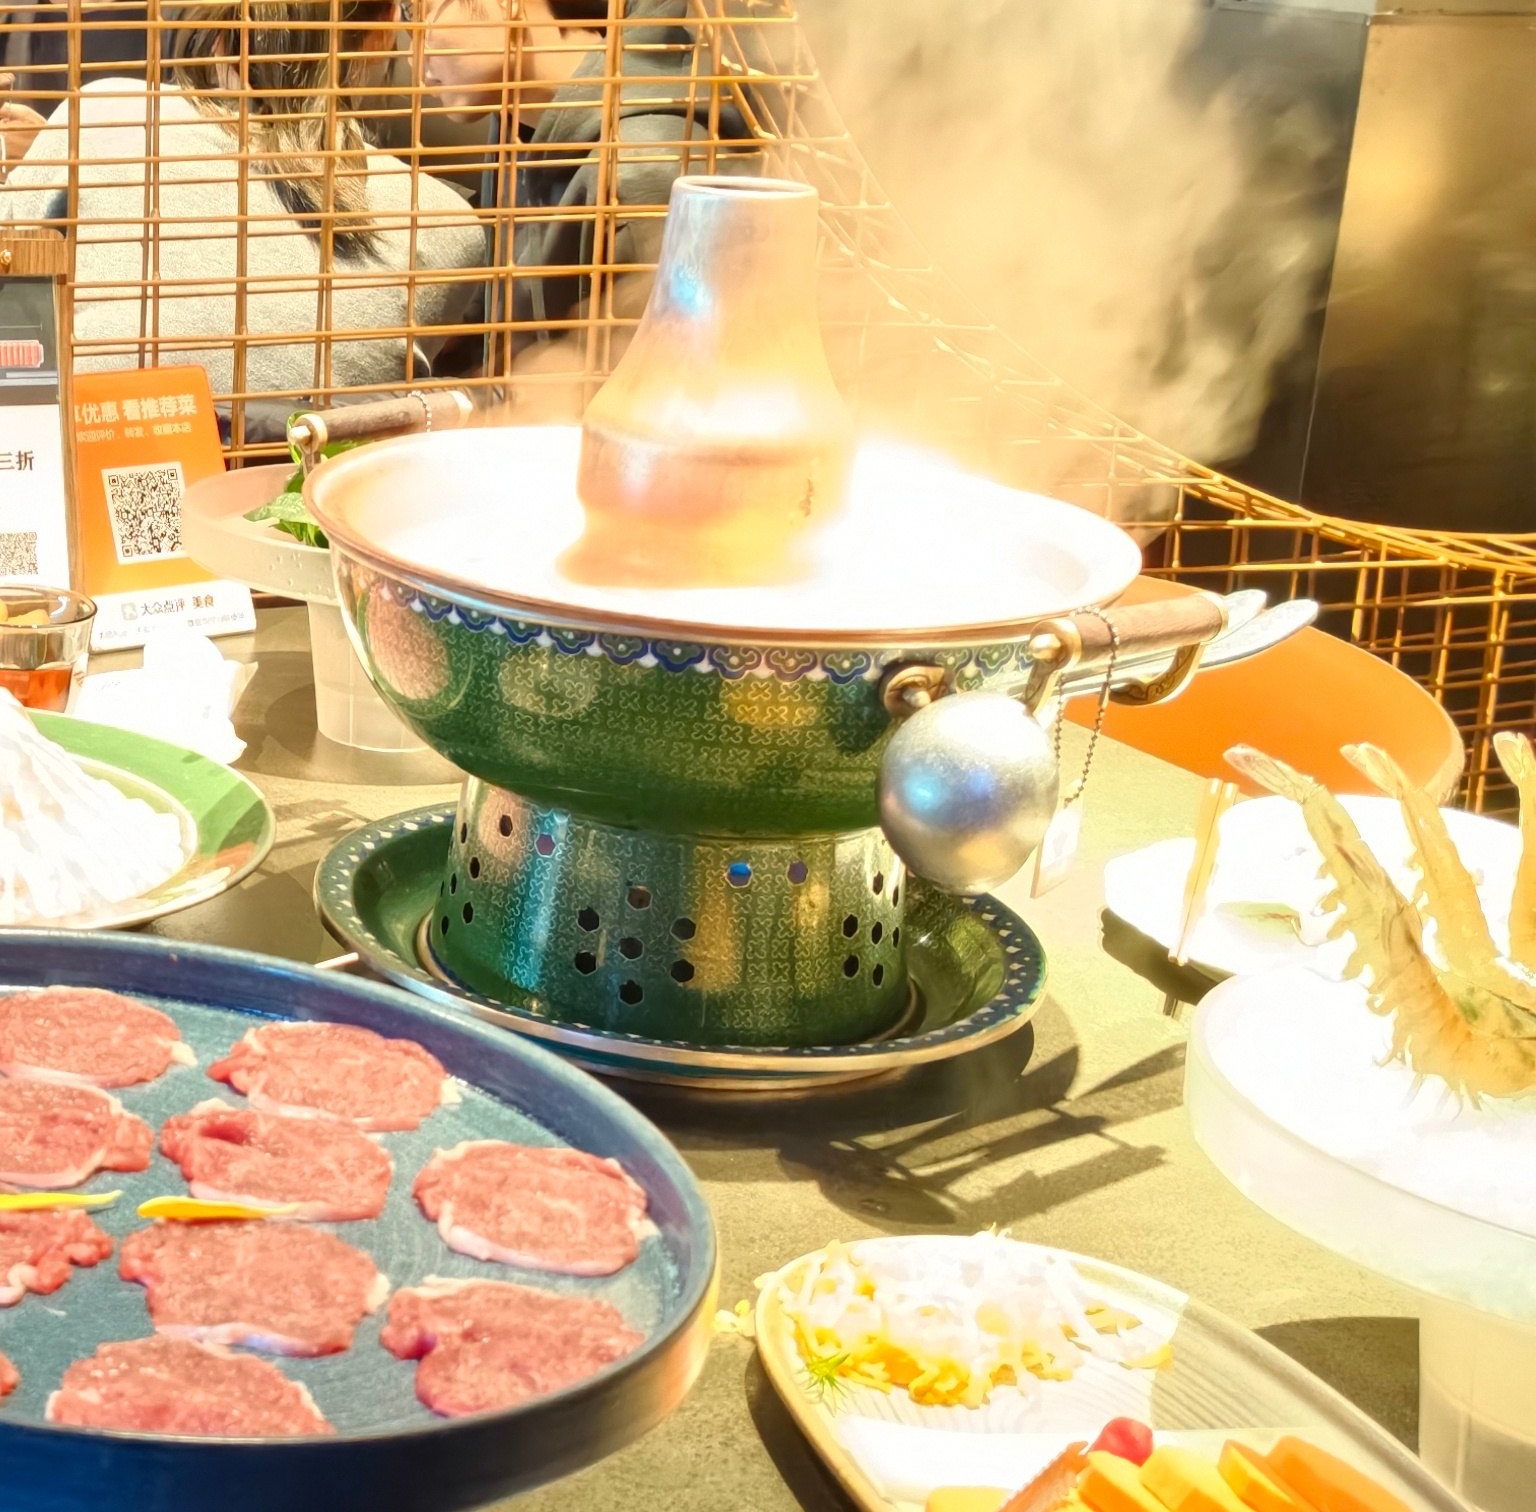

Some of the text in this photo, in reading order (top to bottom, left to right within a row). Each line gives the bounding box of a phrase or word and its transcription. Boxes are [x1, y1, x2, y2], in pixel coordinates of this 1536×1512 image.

[122, 394, 198, 421] 看推荐菜
[140, 594, 214, 616] 大众点评 美食
